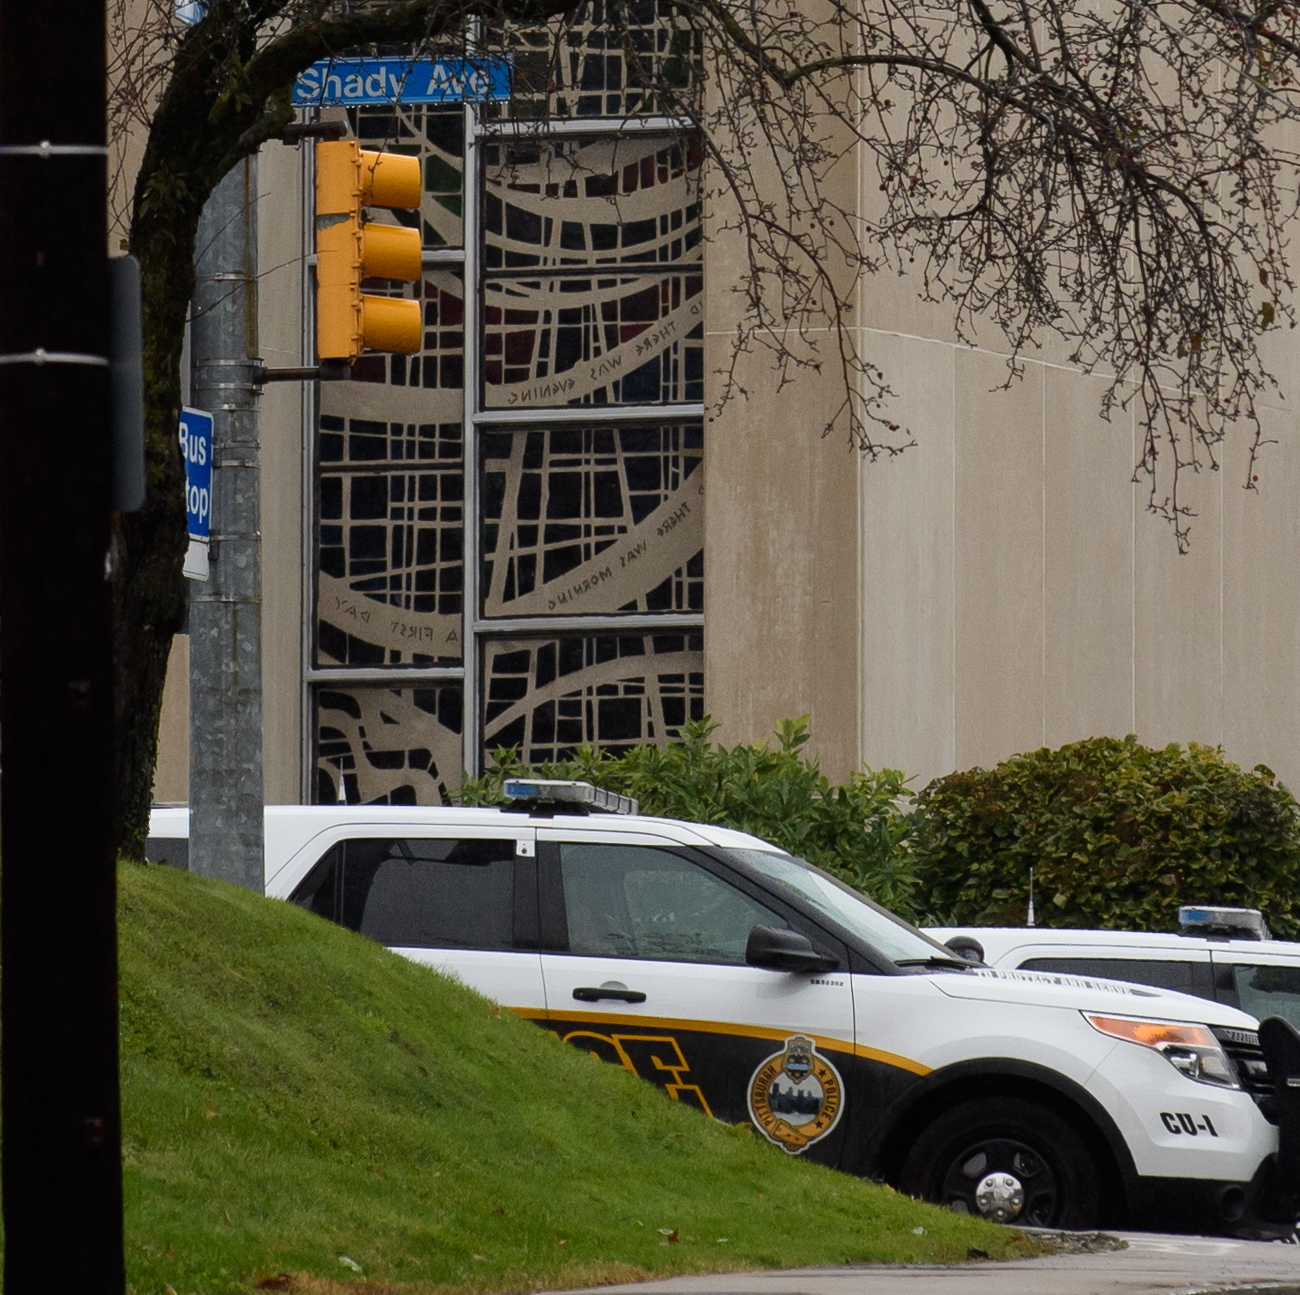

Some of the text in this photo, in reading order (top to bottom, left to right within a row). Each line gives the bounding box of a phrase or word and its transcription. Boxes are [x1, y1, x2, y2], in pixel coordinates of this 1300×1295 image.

[296, 64, 490, 103] Shady Ave
[178, 421, 206, 466] Bus
[185, 475, 209, 524] top
[754, 1063, 778, 1128] PITTSBURGH
[821, 1078, 838, 1122] POLICE
